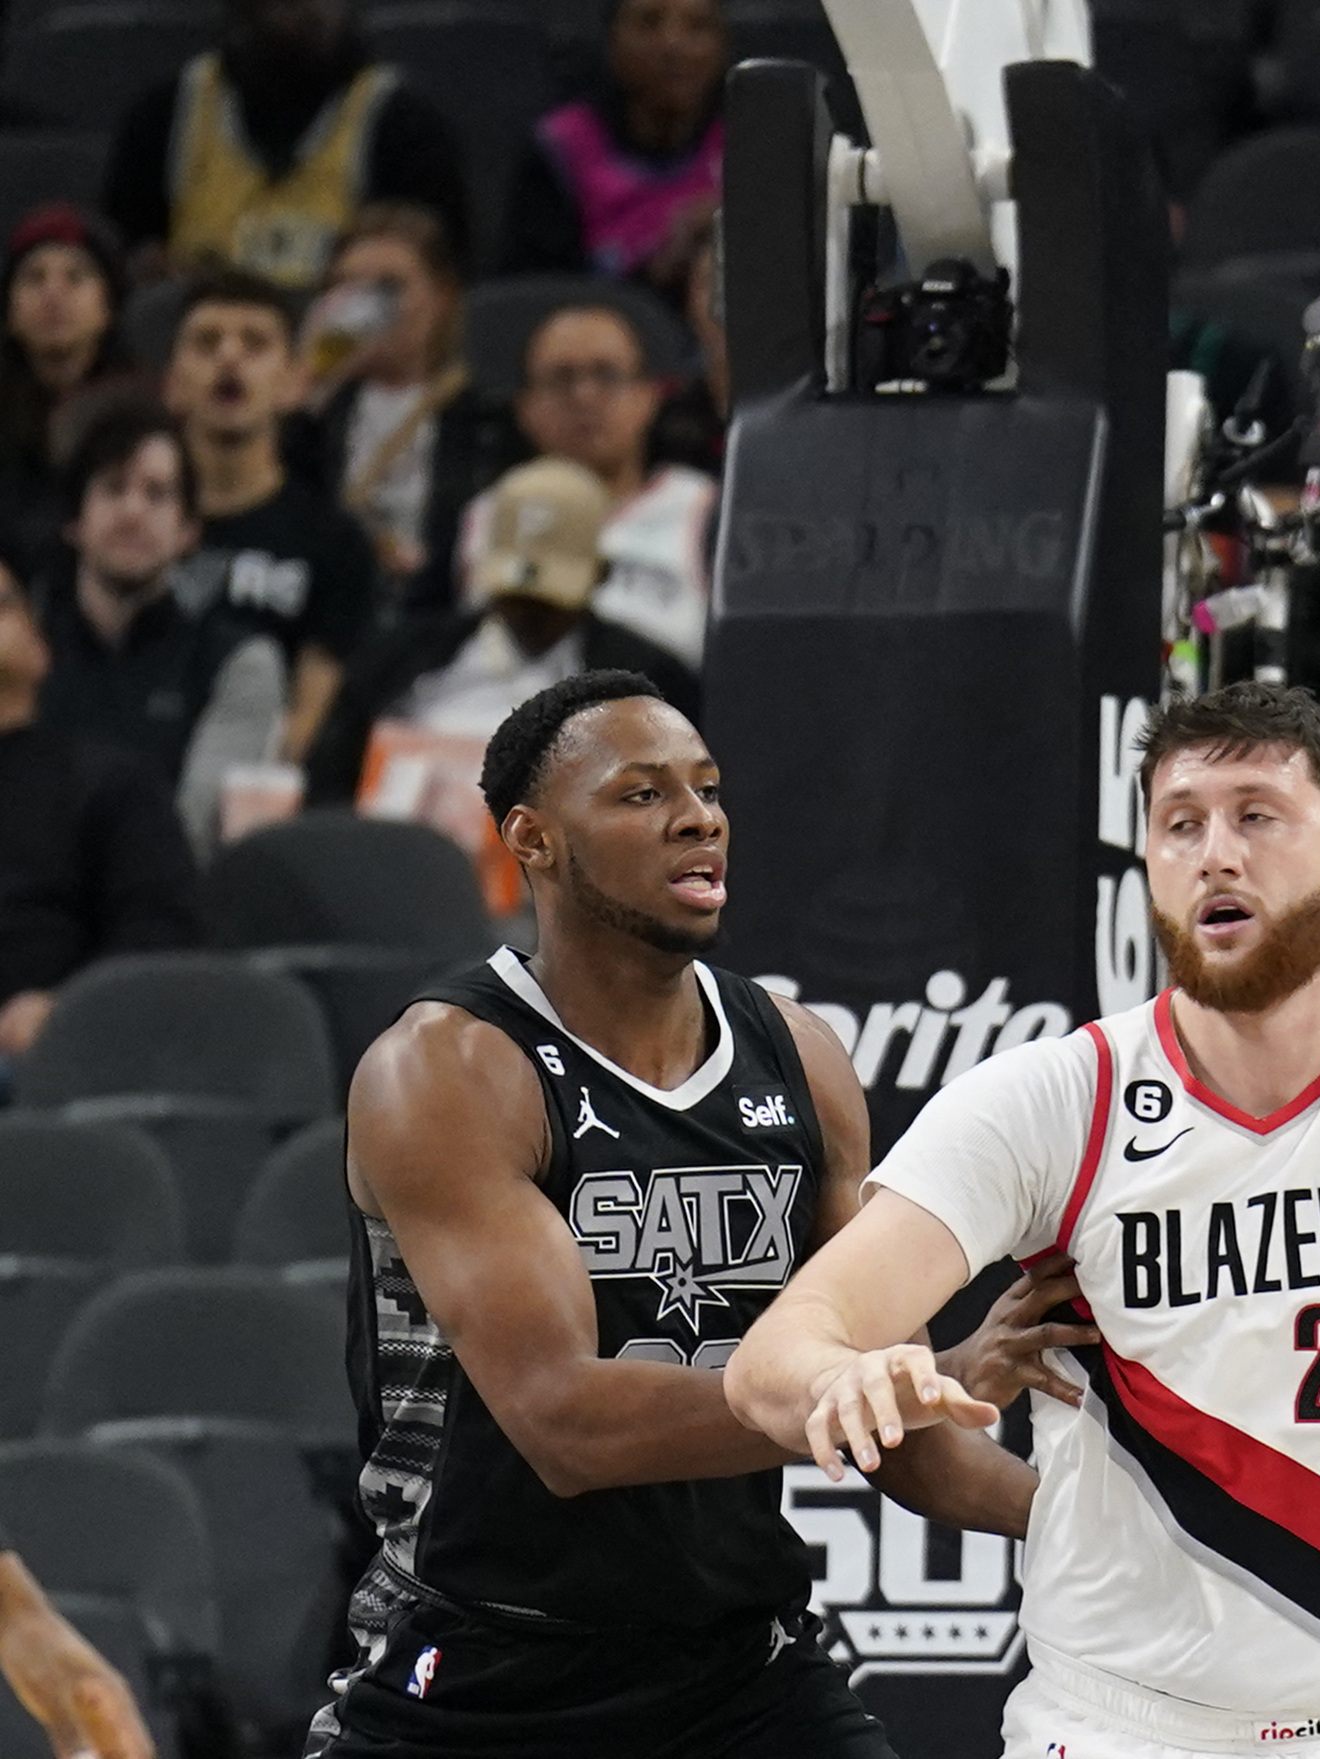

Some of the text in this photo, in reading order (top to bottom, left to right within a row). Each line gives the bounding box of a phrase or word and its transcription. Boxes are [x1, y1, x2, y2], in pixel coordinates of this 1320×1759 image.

[535, 1044, 567, 1076] 6
[738, 1096, 795, 1129] Self.
[1134, 1084, 1163, 1120] 6
[569, 1165, 803, 1288] SATX
